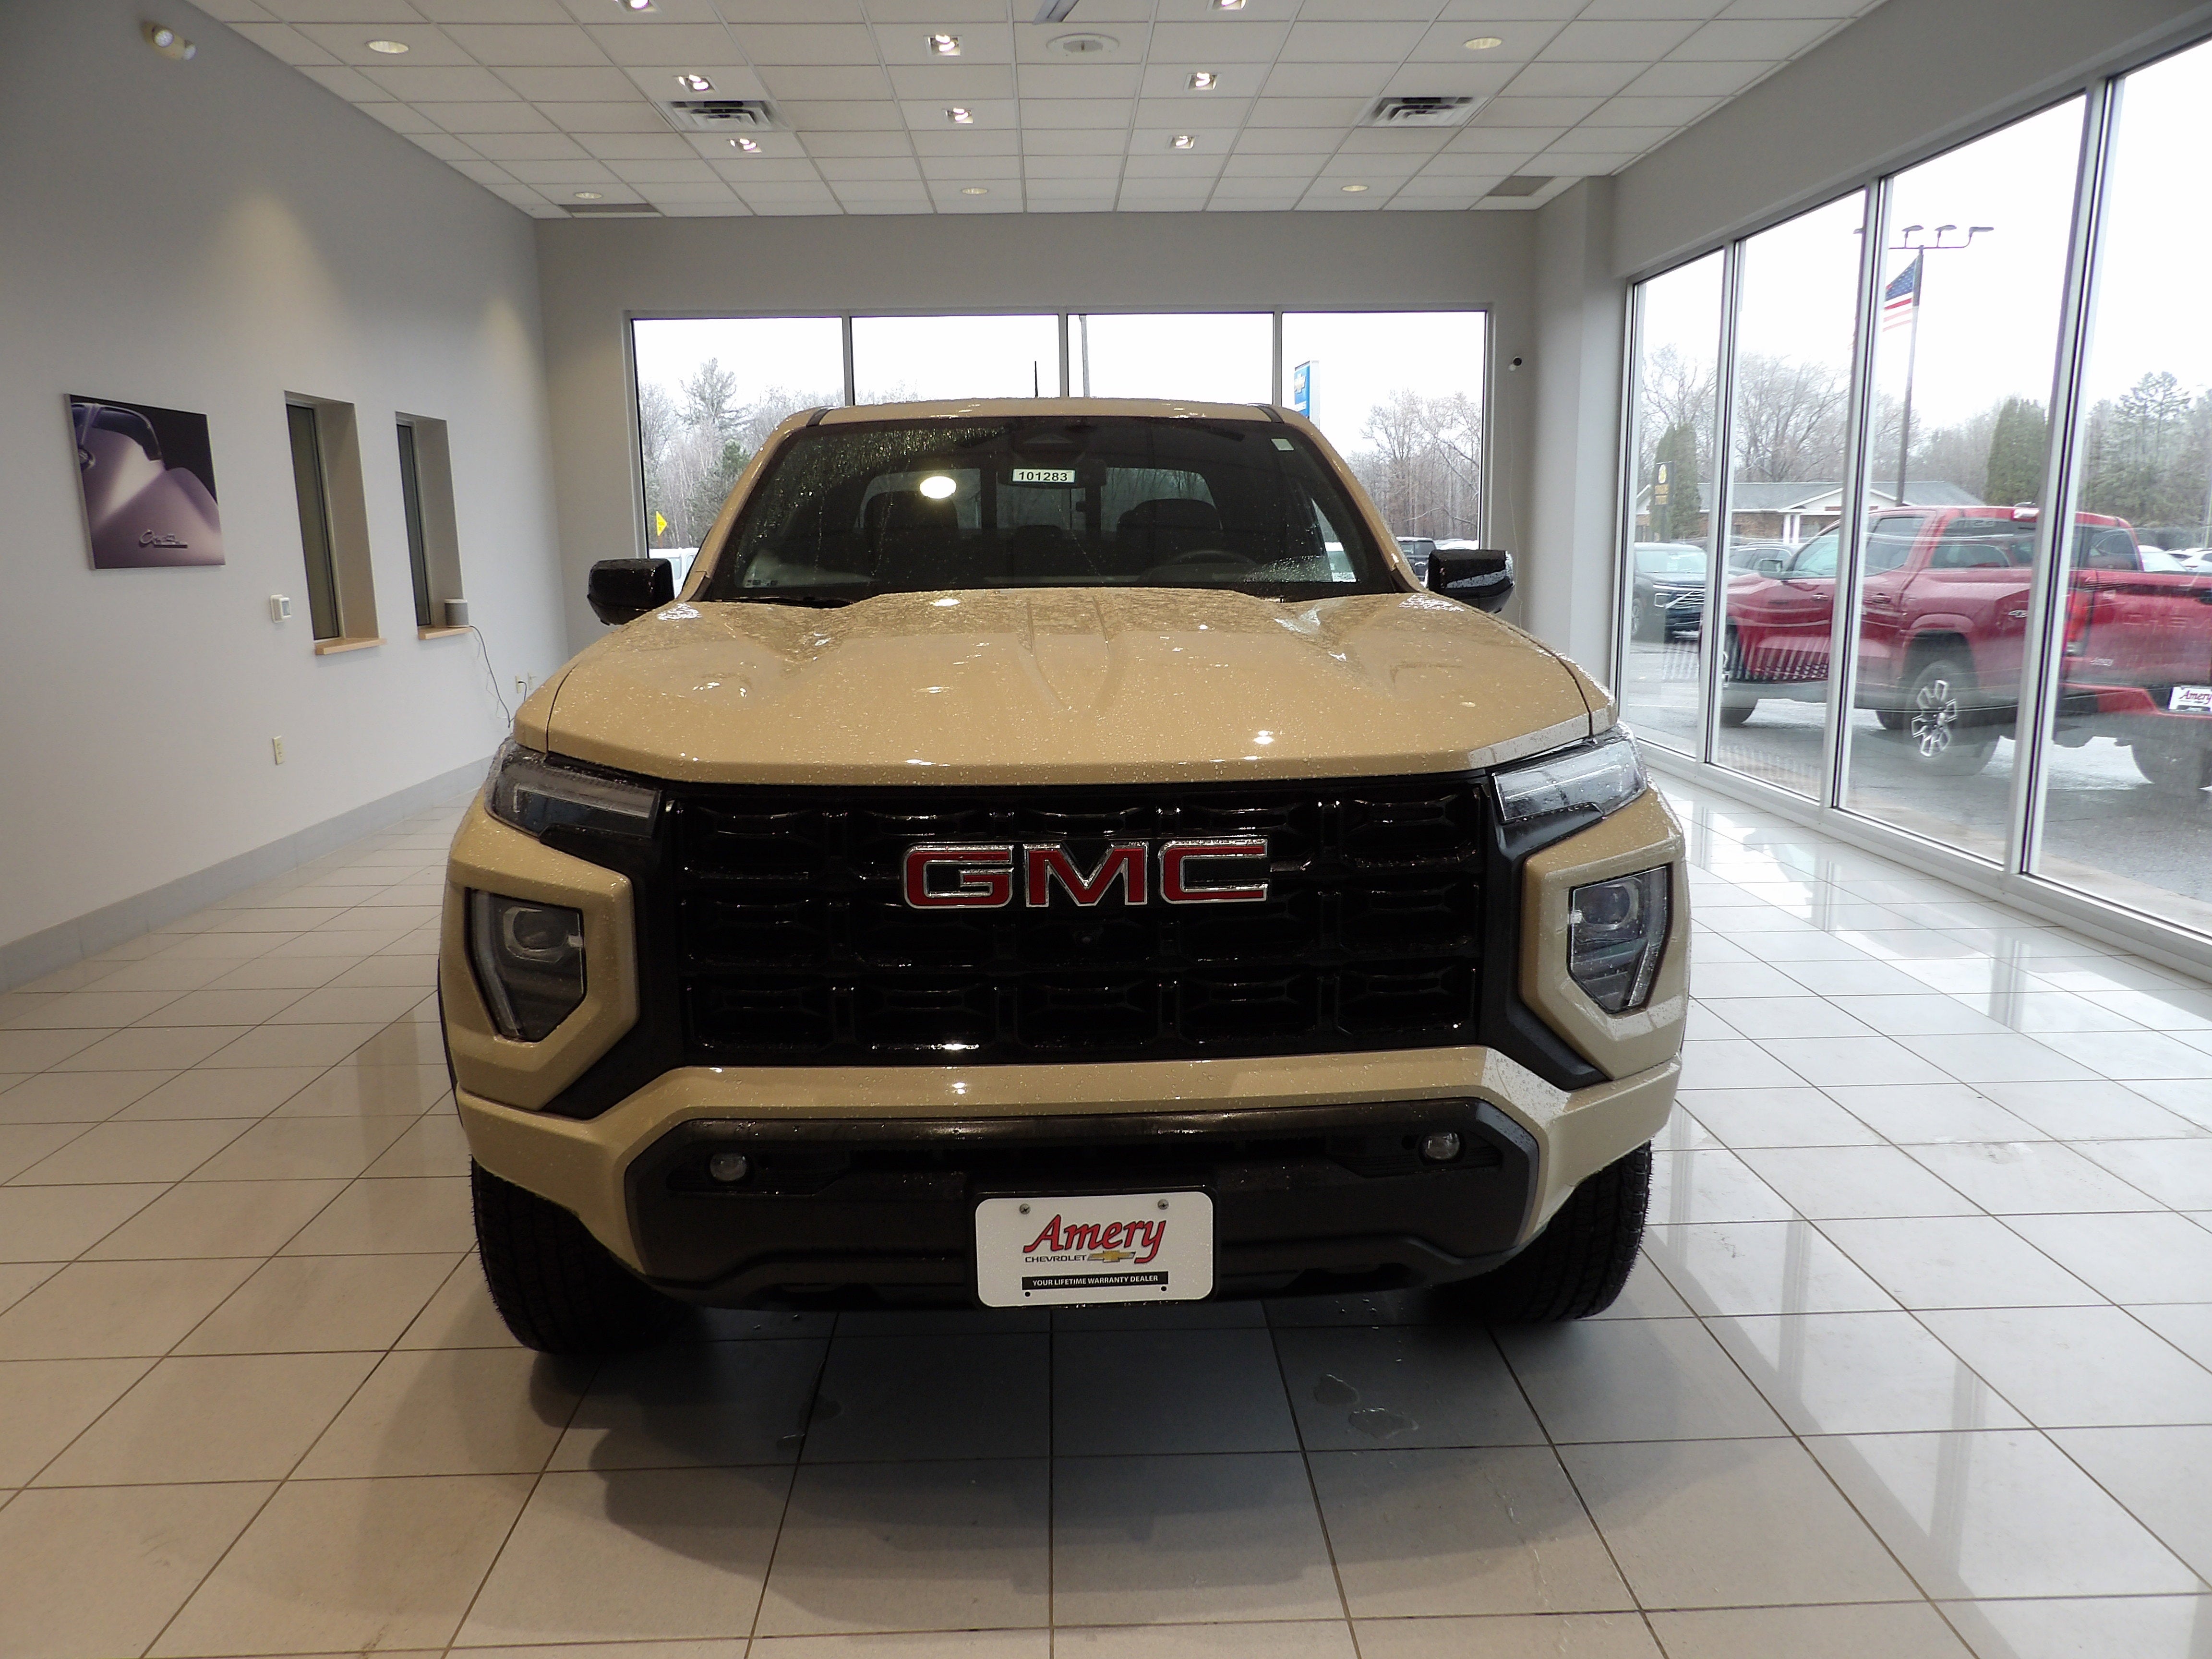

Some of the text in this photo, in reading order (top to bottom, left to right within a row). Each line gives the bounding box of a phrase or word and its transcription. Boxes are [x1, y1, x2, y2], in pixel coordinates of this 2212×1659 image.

[1019, 471, 1068, 481] 101283
[2179, 690, 2212, 705] Amery
[903, 839, 1269, 909] GMC
[1023, 1214, 1166, 1264] Amery
[1025, 1254, 1087, 1262] CHEVROLET
